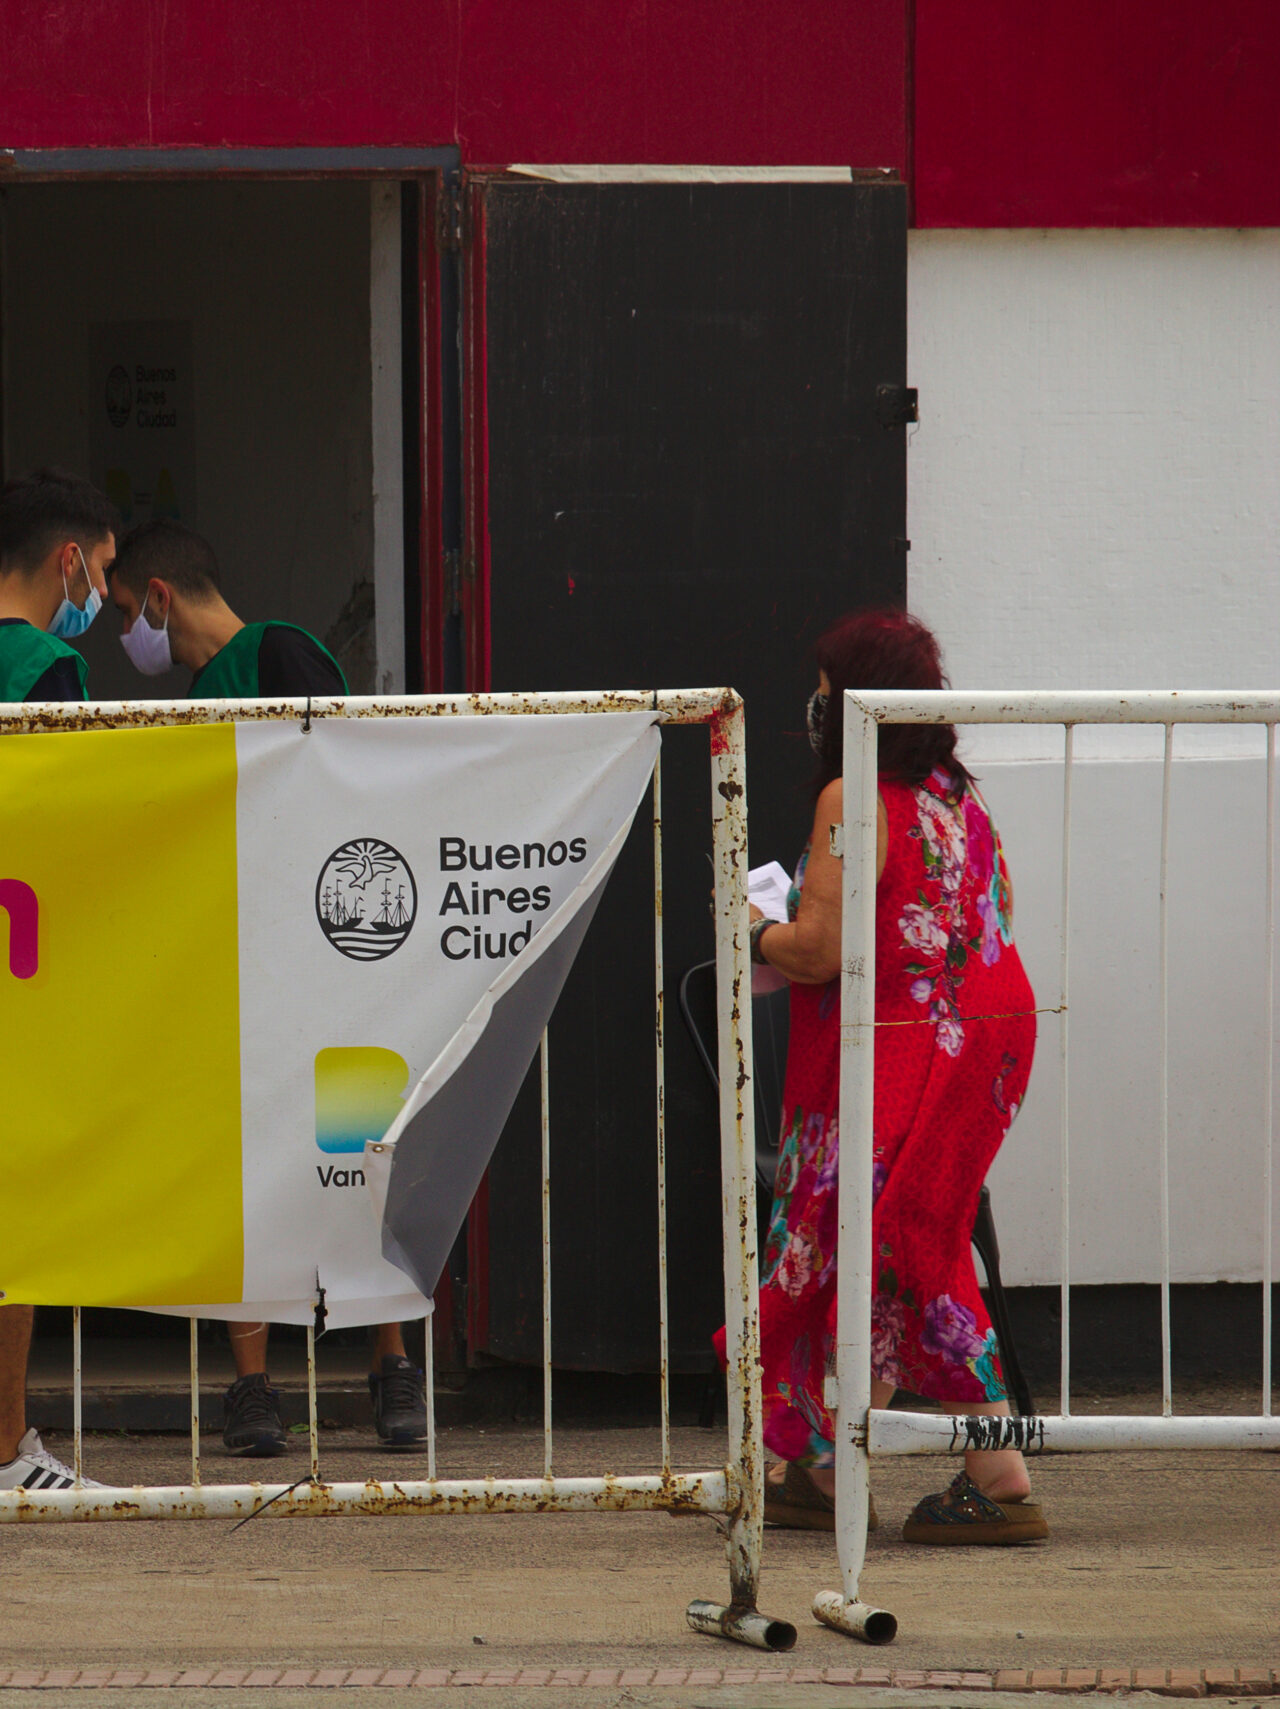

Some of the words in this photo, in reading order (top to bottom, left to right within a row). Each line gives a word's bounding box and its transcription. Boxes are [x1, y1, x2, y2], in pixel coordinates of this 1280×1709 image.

[135, 364, 177, 382] Buenos
[135, 387, 167, 405] Aires
[136, 408, 177, 428] Ciudad
[439, 837, 587, 871] Buenos
[439, 882, 551, 915] Aires
[440, 920, 533, 960] Ciud
